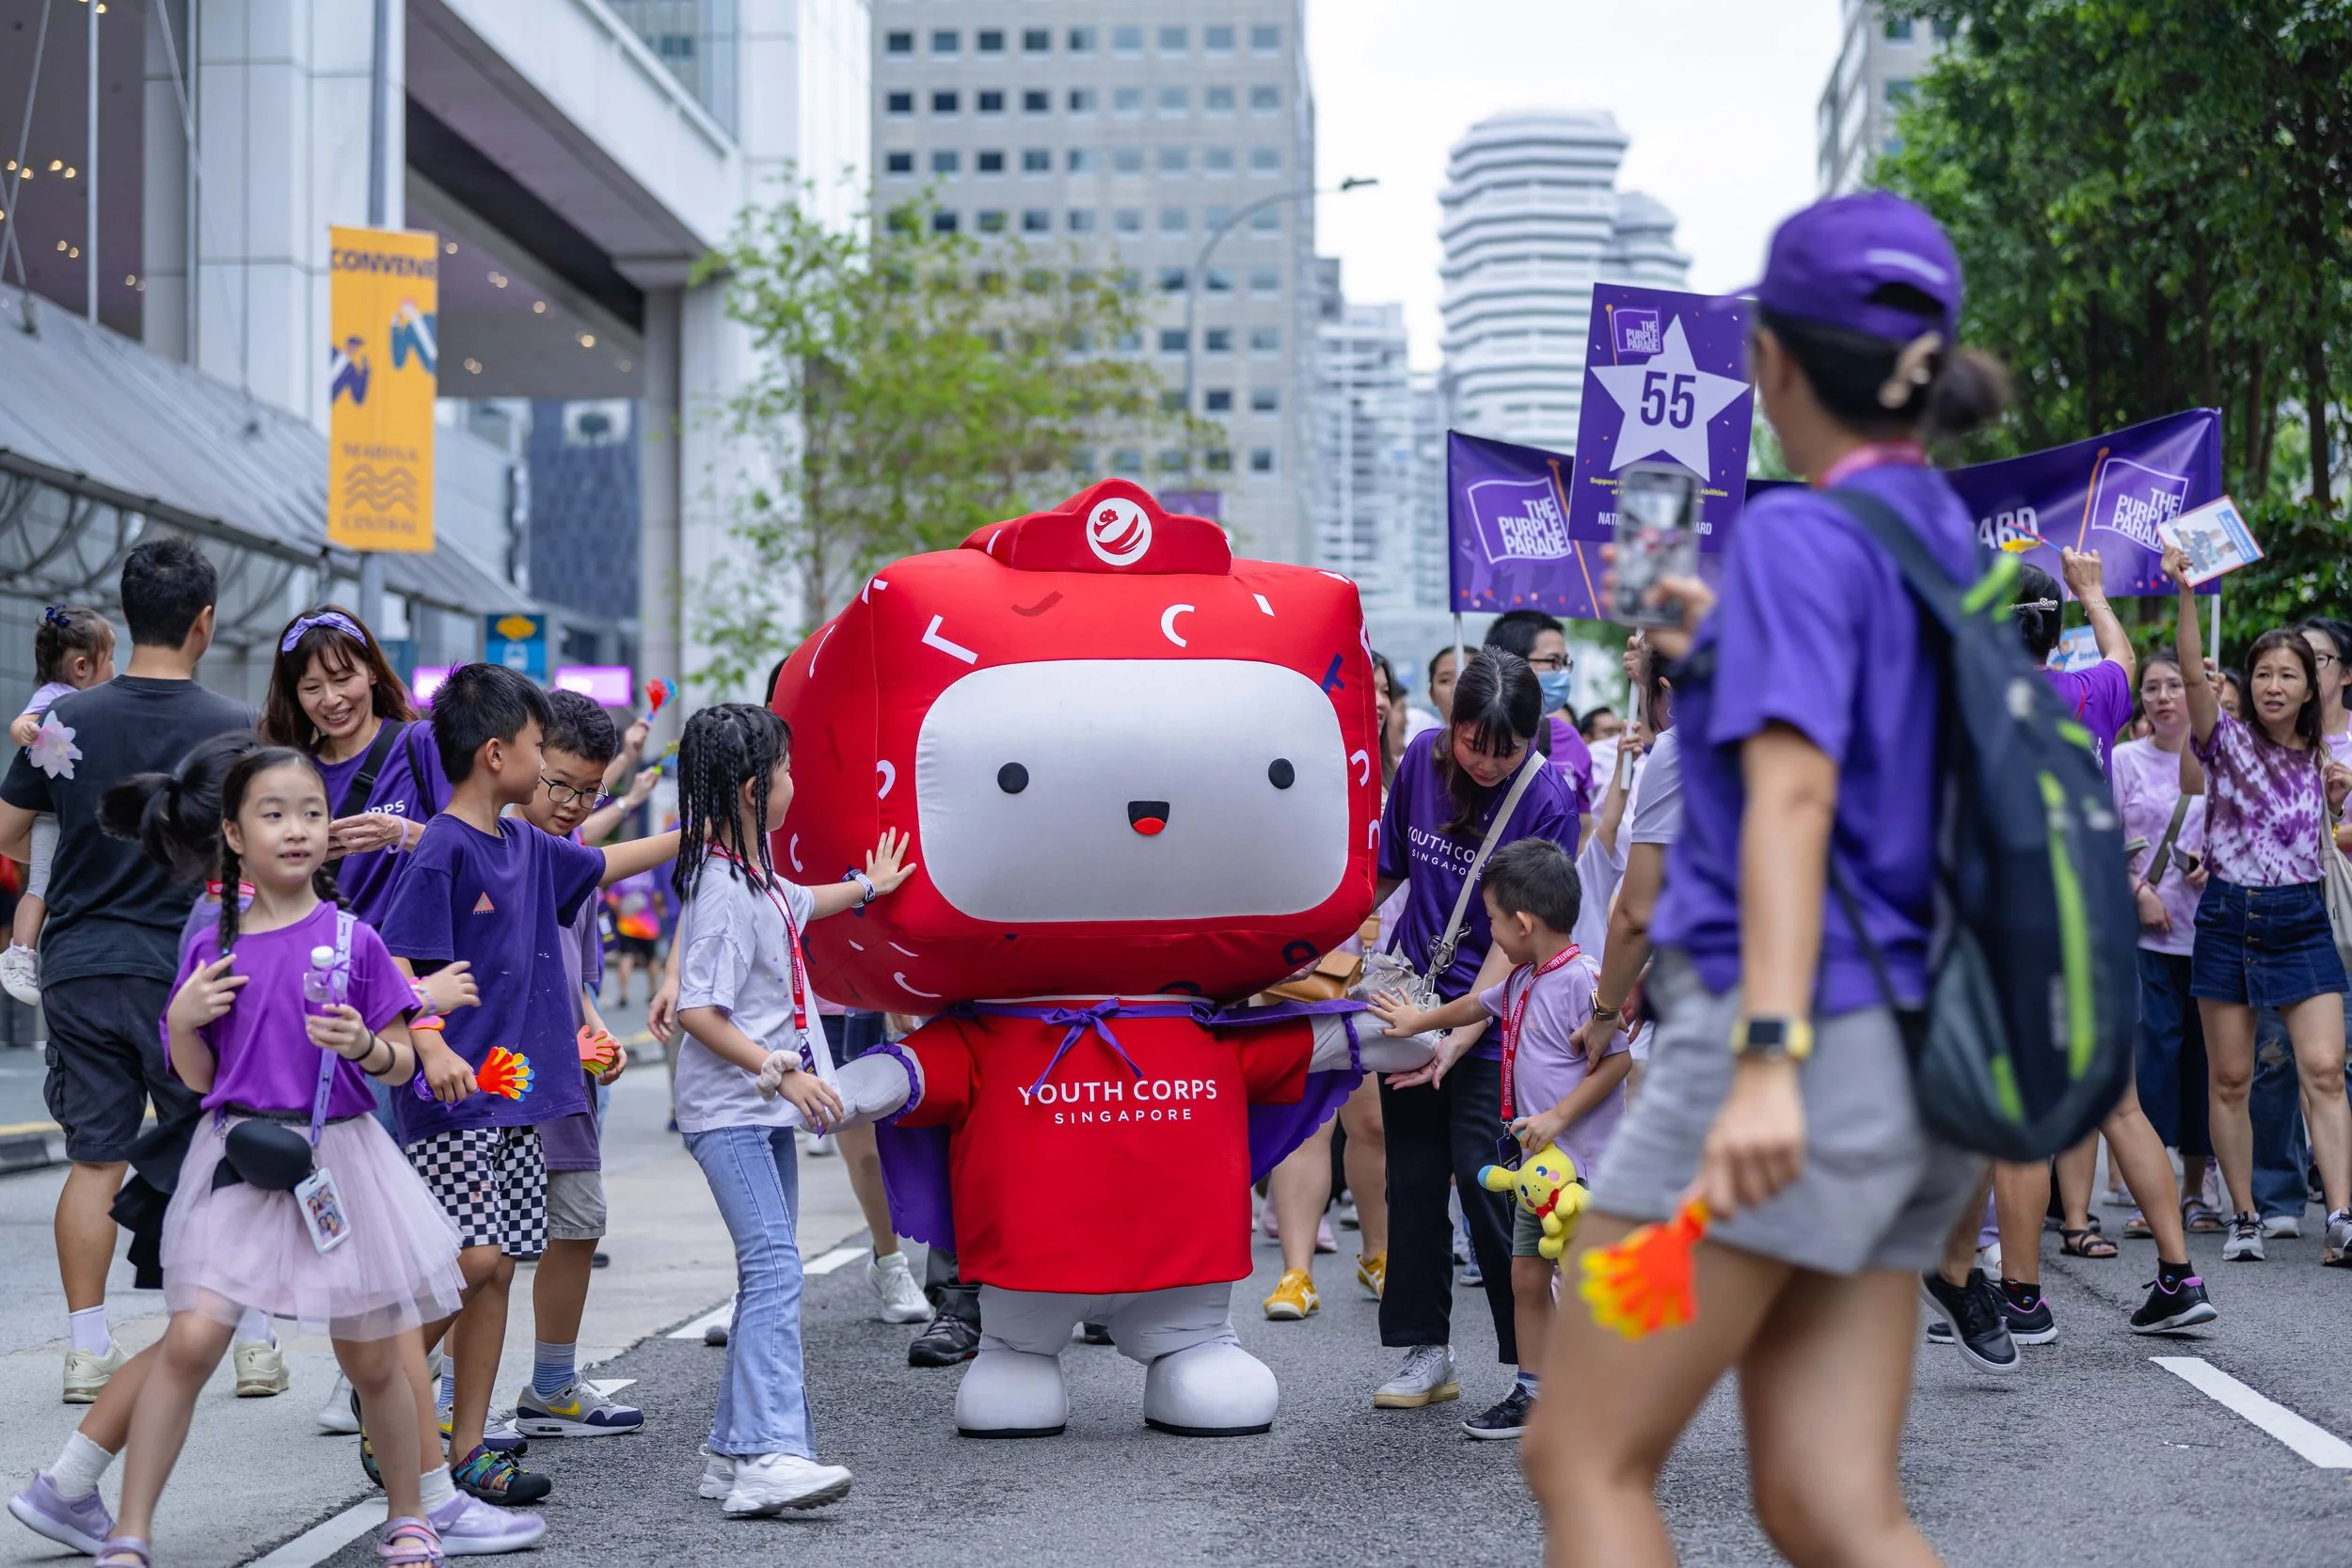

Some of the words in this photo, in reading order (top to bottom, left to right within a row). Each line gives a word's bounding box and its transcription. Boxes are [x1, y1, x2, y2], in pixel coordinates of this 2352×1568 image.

[1626, 328, 1659, 341] PURPLE
[1641, 321, 1657, 331] THE
[1628, 339, 1661, 353] PARADE
[1640, 371, 1696, 429] 55
[1700, 488, 1728, 498] Abilities
[2151, 487, 2182, 514] THE
[1521, 497, 1555, 520] THE
[1597, 512, 1624, 527] NATIO
[1498, 514, 1561, 537] PURPLE
[1977, 506, 2039, 549] ARD
[2111, 511, 2165, 550] PARAD
[1503, 531, 1567, 557] PARADE
[1407, 825, 1452, 855] YOUTH
[1411, 848, 1482, 880] SINGAPOE
[1018, 1081, 1123, 1106] YOUTH
[1134, 1080, 1217, 1101] CORPS
[1055, 1108, 1192, 1125] SINGAPORE
